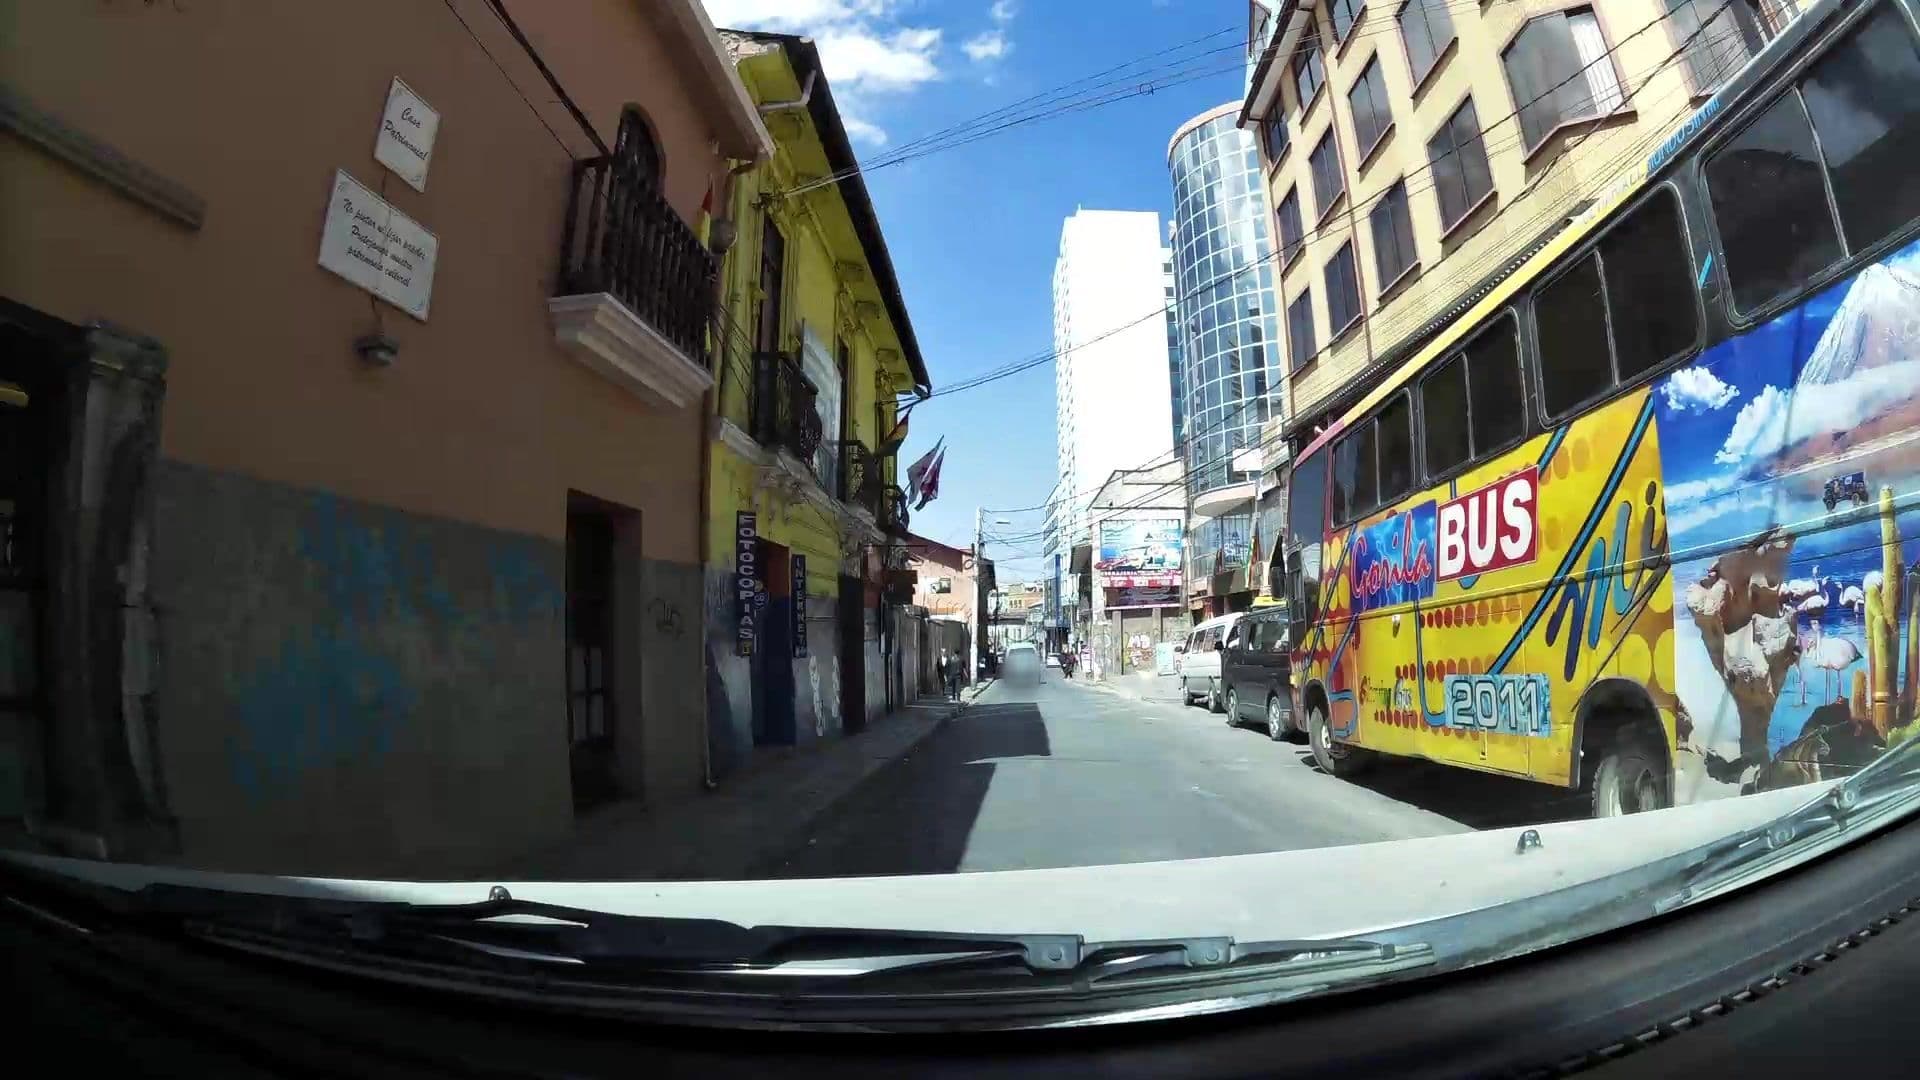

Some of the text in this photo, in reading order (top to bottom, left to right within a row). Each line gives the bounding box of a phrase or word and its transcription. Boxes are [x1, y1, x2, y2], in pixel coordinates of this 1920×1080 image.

[384, 119, 429, 161] Patrimonial
[343, 198, 354, 214] No
[1440, 479, 1533, 577] BUS
[738, 515, 755, 639] FOTOCOPIAS
[794, 557, 806, 645] INTERNET
[1451, 679, 1539, 732] 2011
